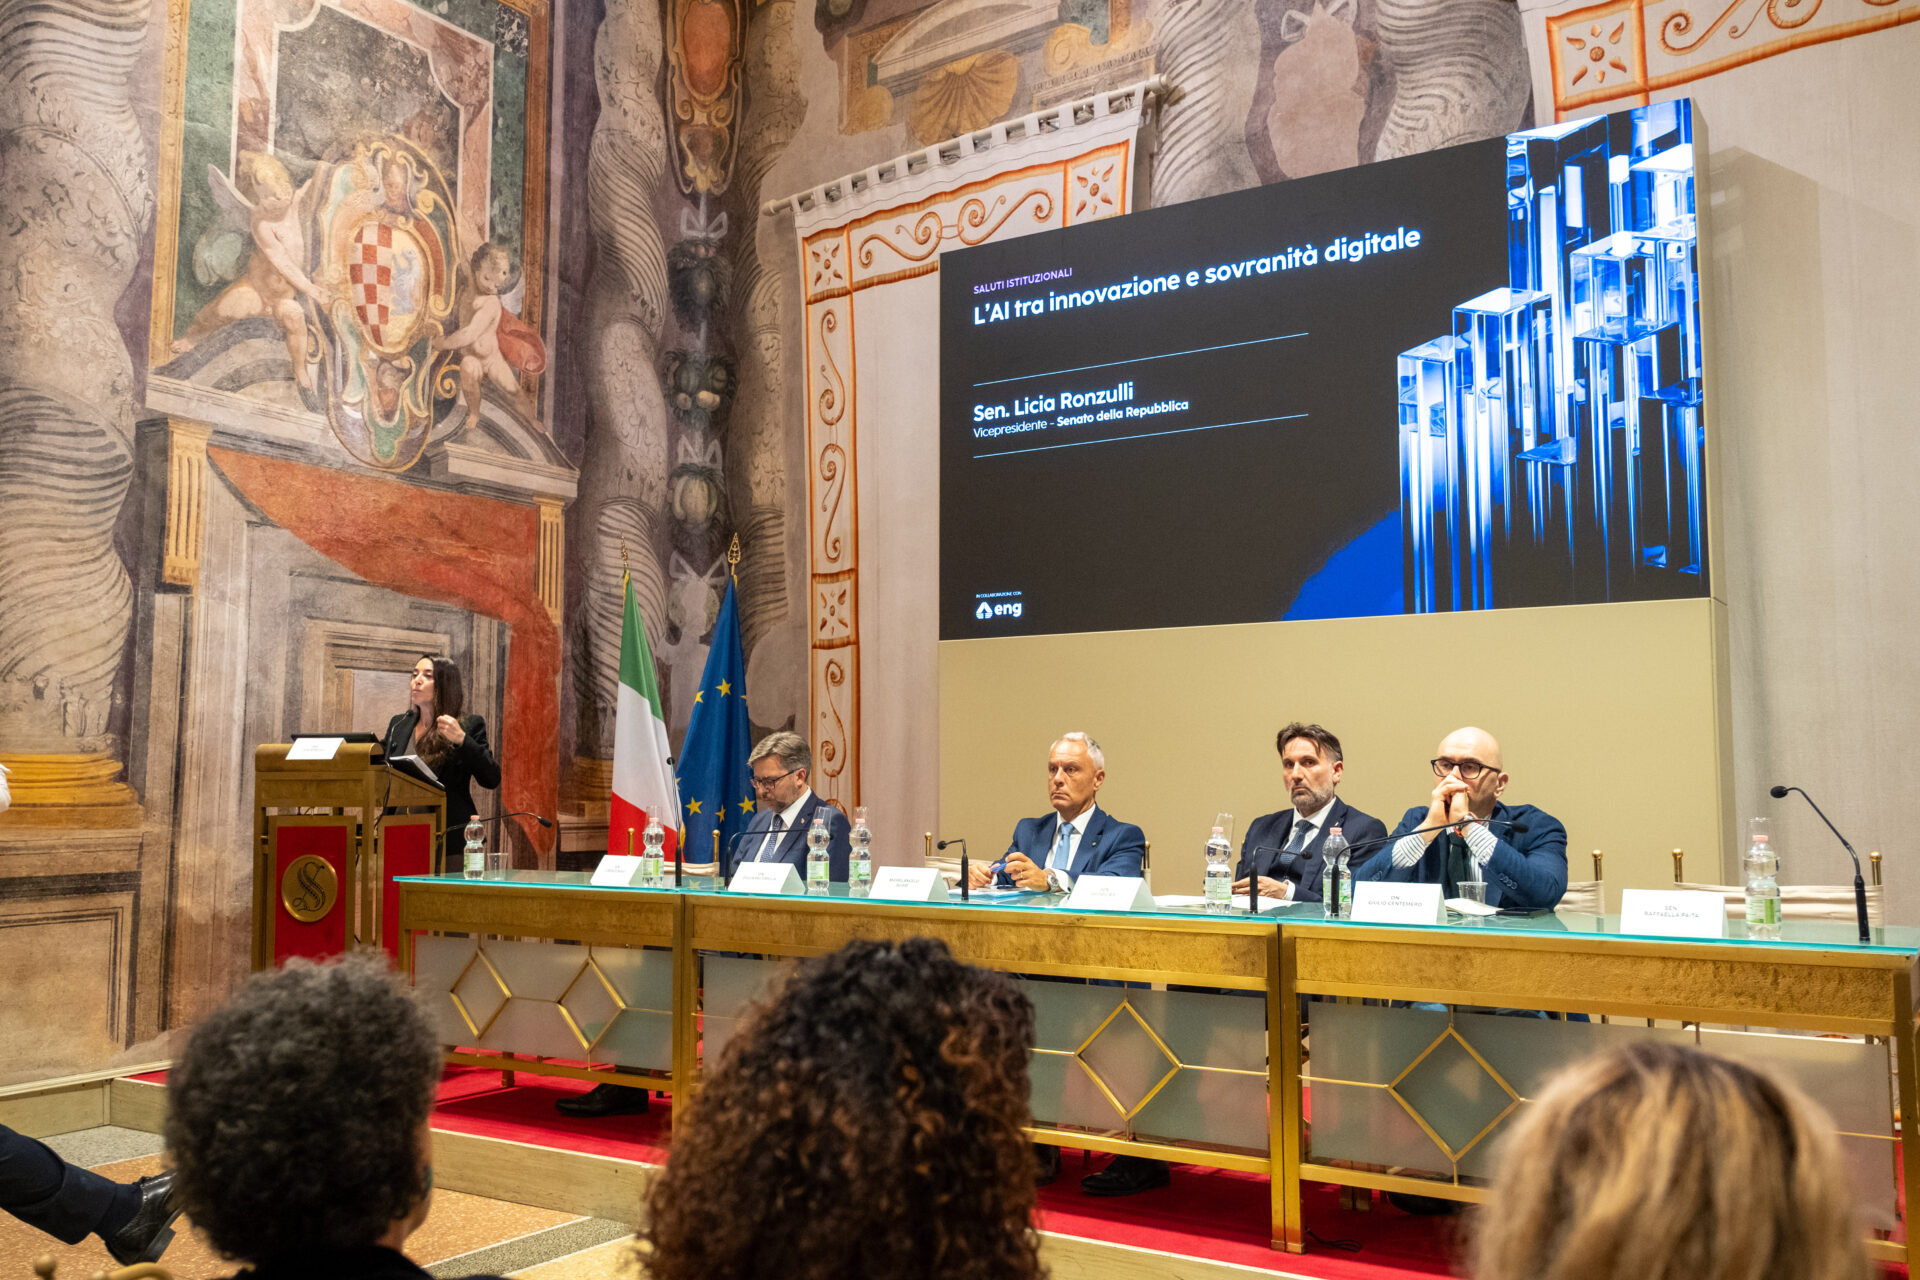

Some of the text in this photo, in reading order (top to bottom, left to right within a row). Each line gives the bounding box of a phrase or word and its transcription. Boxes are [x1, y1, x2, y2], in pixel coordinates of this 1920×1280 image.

[973, 267, 1073, 294] SALUTI ISTITUZIONALI
[974, 226, 1422, 325] L’AI tra innovazione e sovranità digitale
[973, 381, 1134, 421] Sen. Licia Ronzulli
[973, 420, 1048, 438] Vicepresidente
[1056, 413, 1095, 427] Senato
[1096, 409, 1124, 422] della
[1125, 400, 1190, 418] Repubblica
[994, 603, 1022, 618] eng
